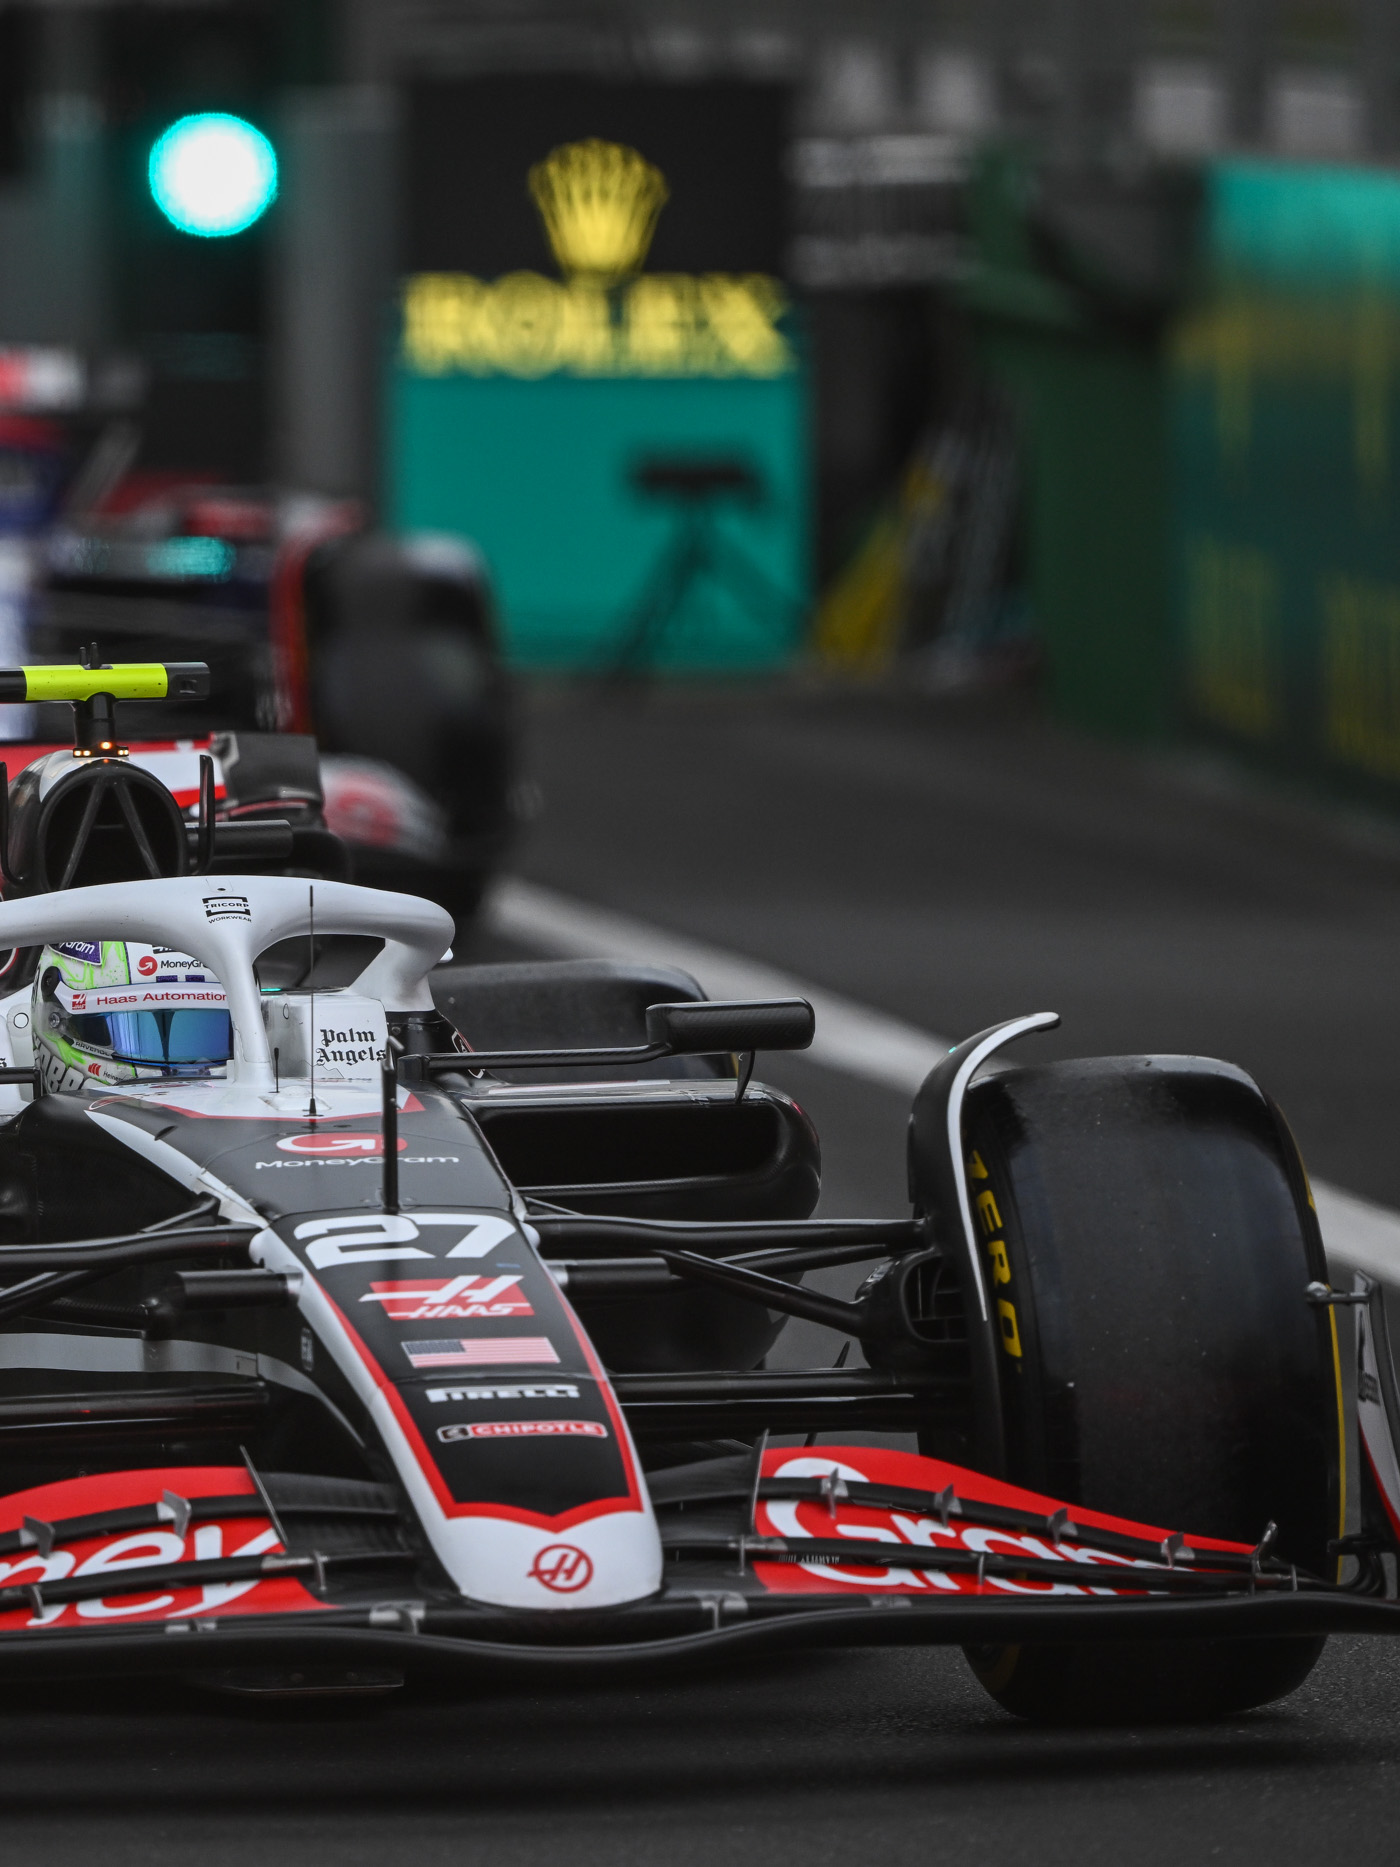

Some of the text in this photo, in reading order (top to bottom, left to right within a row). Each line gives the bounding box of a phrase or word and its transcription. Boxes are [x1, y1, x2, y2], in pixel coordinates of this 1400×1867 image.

[208, 915, 252, 924] WORKWEAR
[96, 994, 138, 1006] Haas
[319, 1027, 377, 1047] Palm
[315, 1045, 387, 1066] Angels
[255, 1156, 460, 1170] MoneyGam
[294, 1212, 517, 1271] 27
[388, 1302, 532, 1319] HAAS
[425, 1383, 580, 1403] PIRELLI
[475, 1423, 597, 1437] CHIPOTLE
